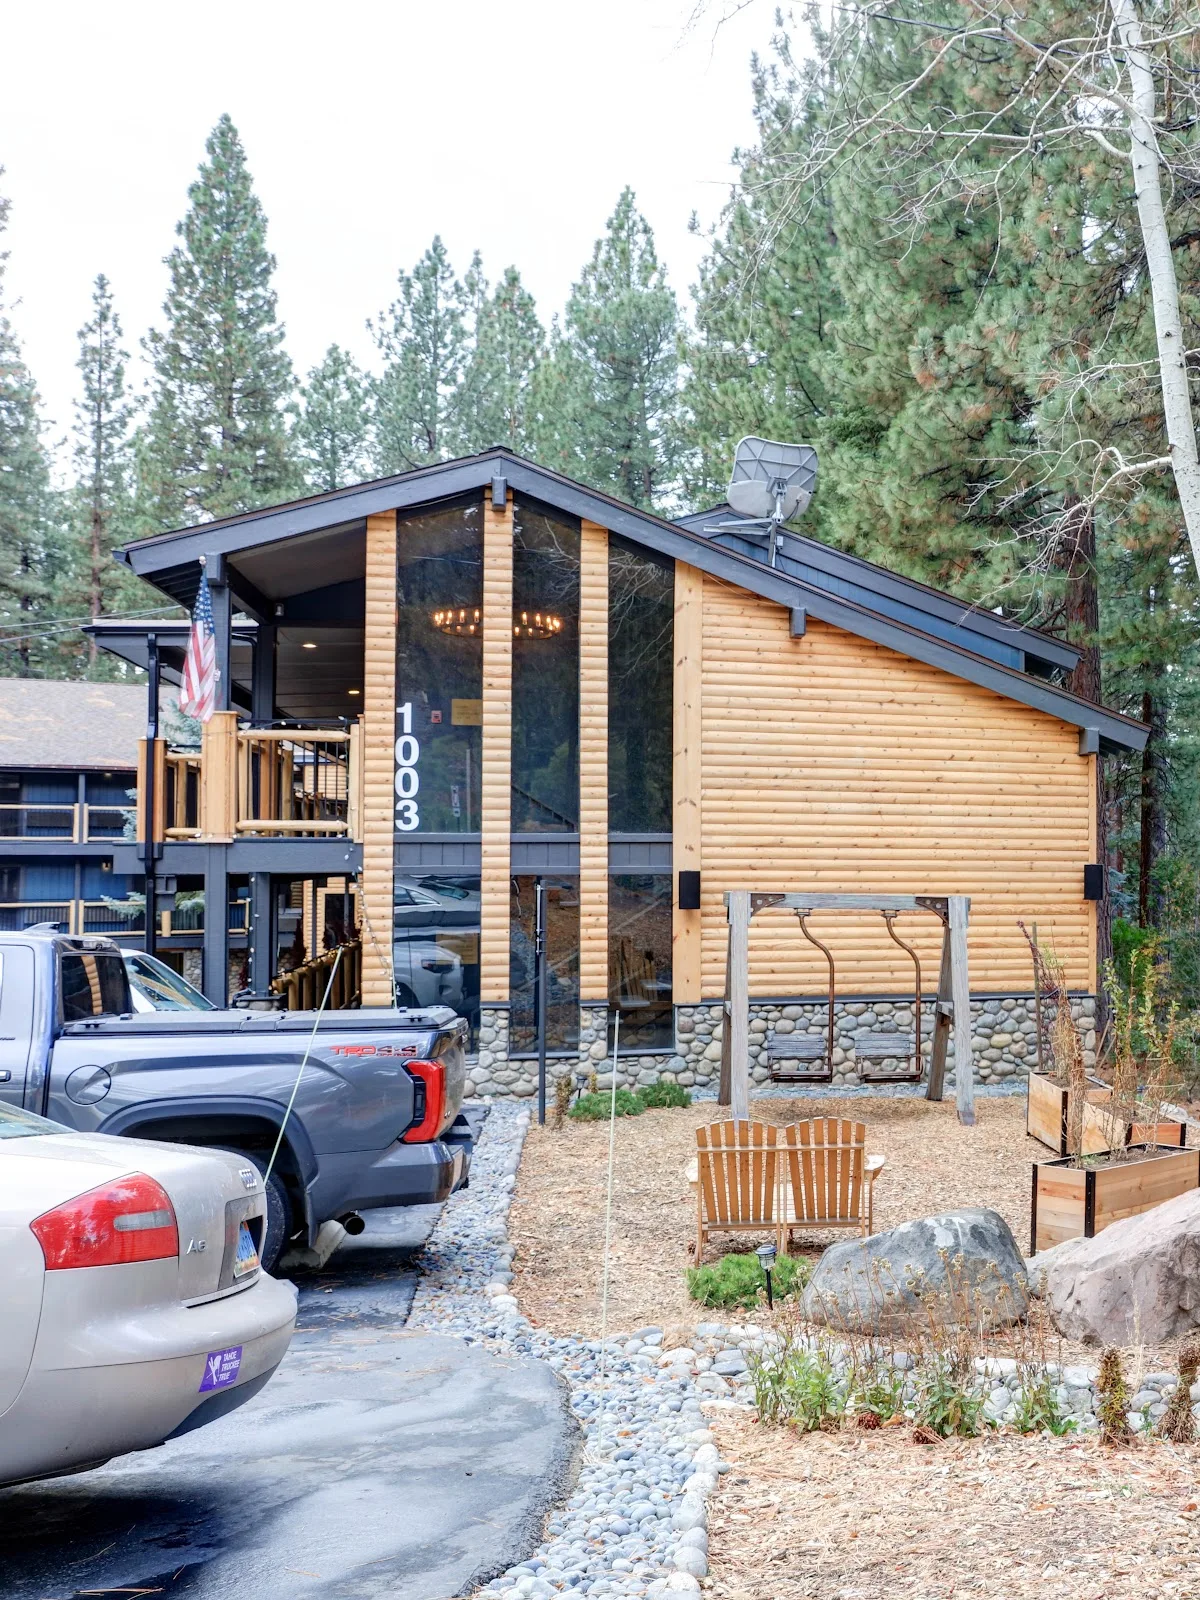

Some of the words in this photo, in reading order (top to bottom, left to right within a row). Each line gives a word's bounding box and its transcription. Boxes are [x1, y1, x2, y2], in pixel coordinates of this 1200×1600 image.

[395, 703, 419, 831] 1003
[329, 1045, 376, 1057] TRD
[186, 1237, 206, 1254] A6
